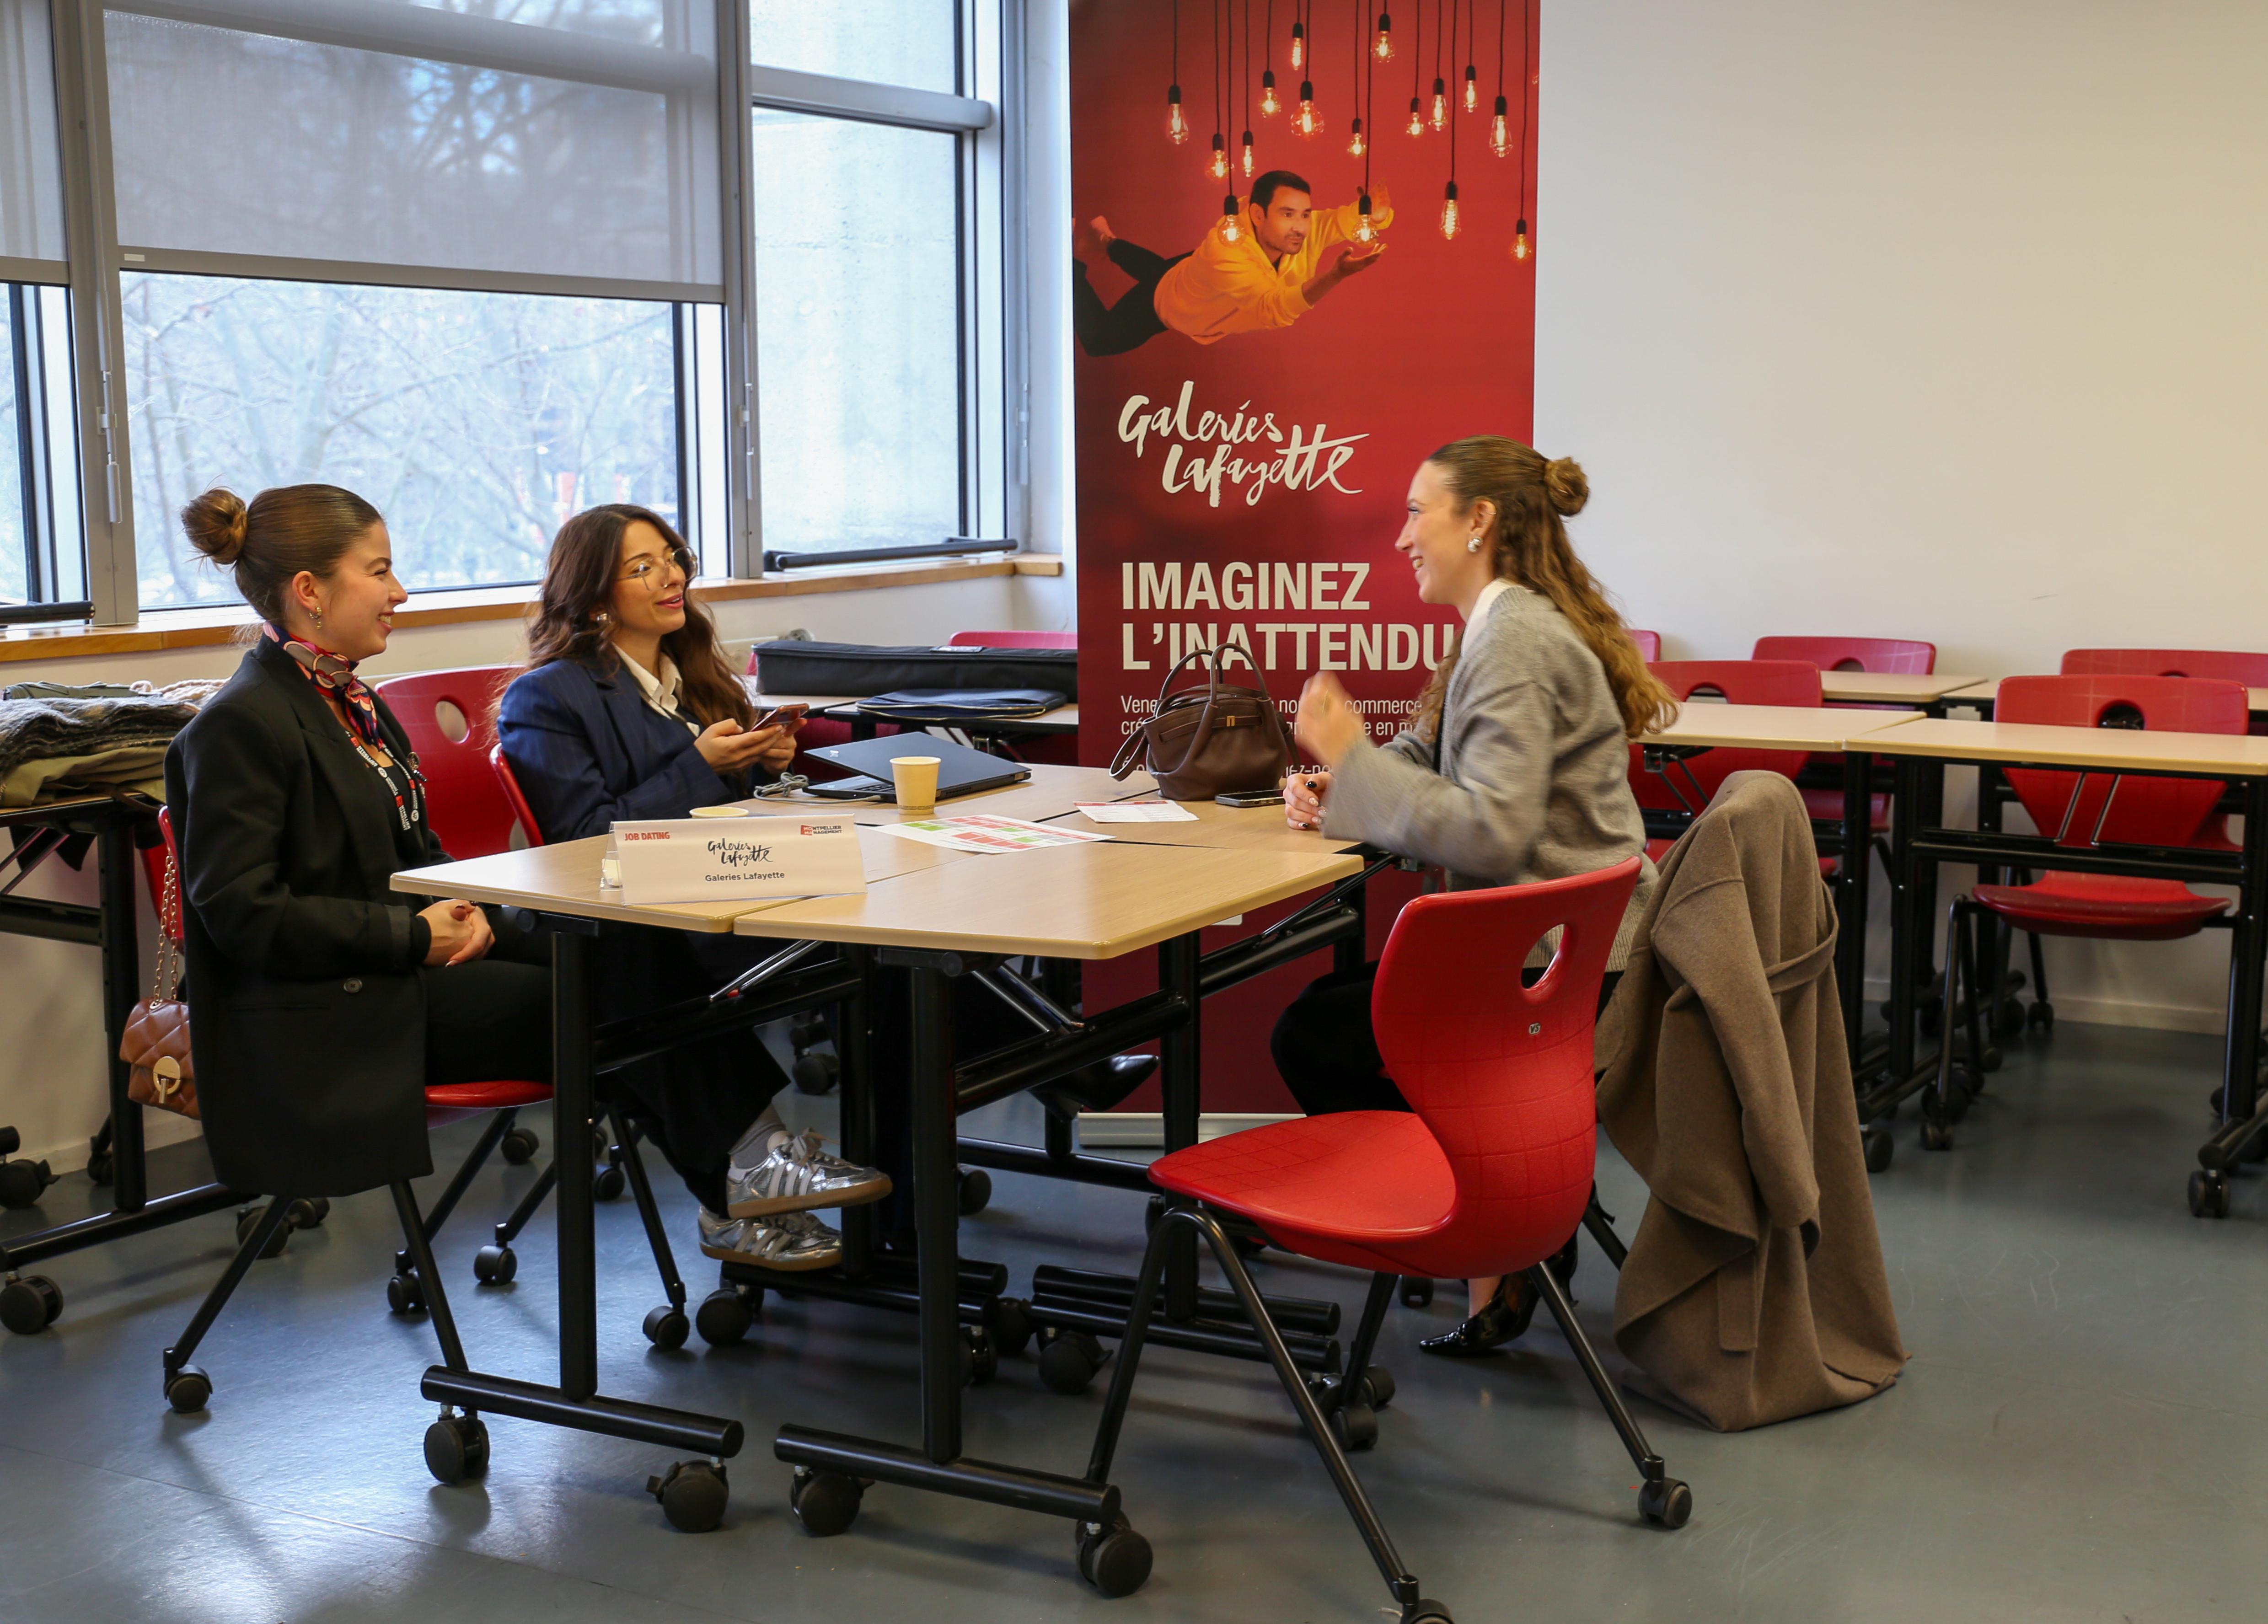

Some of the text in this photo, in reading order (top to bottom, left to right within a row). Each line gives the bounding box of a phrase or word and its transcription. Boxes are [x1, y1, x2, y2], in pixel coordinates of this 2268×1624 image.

[1118, 381, 1283, 457] Galeries
[1162, 424, 1370, 508] Lafayette
[1122, 563, 1370, 610] IMAGINEZ
[1122, 622, 1454, 671] L’INATTENDU
[1376, 721, 1394, 736] en
[624, 831, 670, 841] JOB DATING
[708, 838, 751, 855] Galeries
[721, 845, 774, 867] Lafayette
[705, 871, 785, 882] Galeries Lafayette
